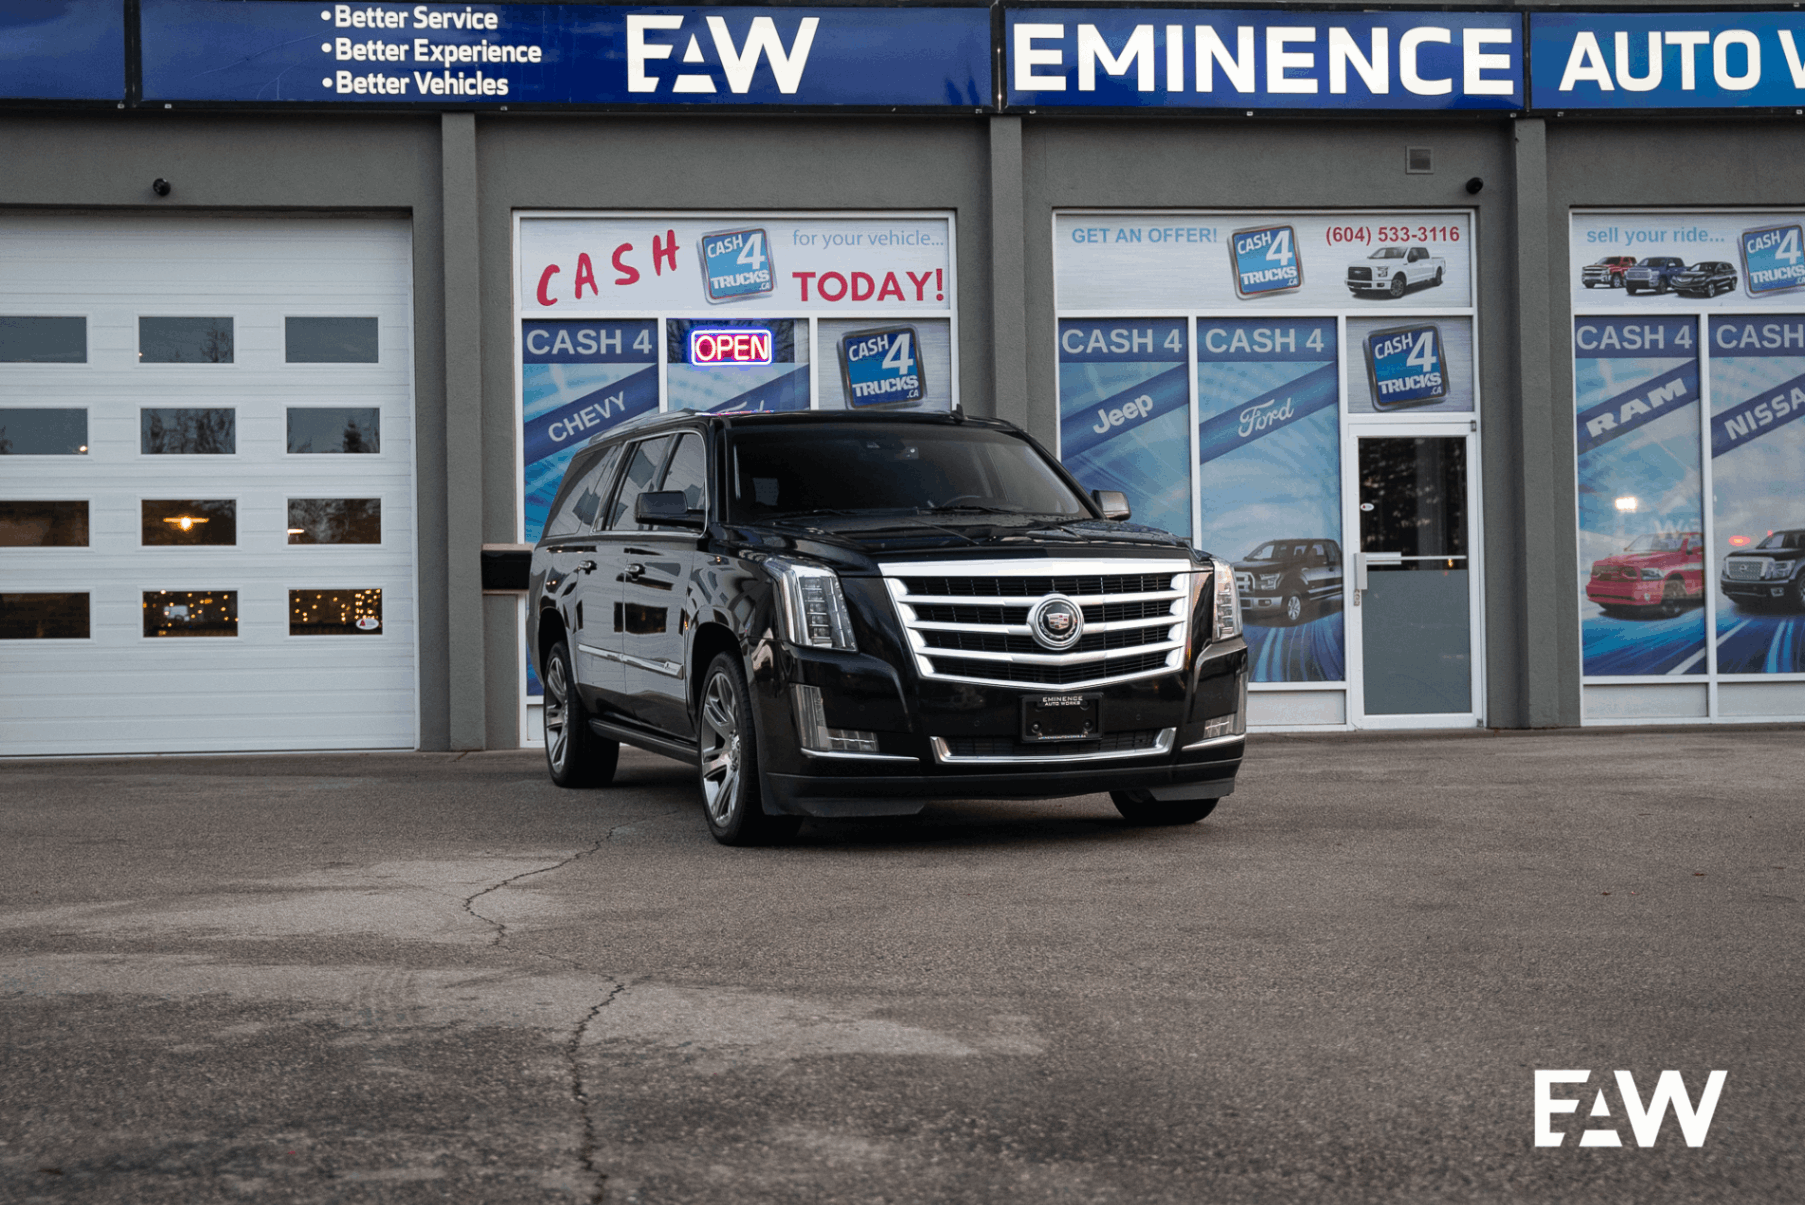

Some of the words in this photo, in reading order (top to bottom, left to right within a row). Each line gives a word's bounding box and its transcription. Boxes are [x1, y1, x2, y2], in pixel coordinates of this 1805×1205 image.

[335, 5, 409, 29] Better
[413, 6, 499, 30] Service
[336, 37, 409, 61] Better
[414, 39, 543, 68] Experience
[626, 15, 820, 94] EAW
[1013, 23, 1514, 95] EMINENCE
[1559, 29, 1762, 91] AUTO
[336, 70, 410, 94] Better
[413, 70, 509, 95] Vehicles
[793, 229, 818, 246] for
[822, 233, 863, 250] your
[868, 229, 944, 246] vehicle...
[1072, 228, 1110, 243] GET
[1115, 228, 1142, 243] AN
[1148, 228, 1217, 243] OFFER!
[1237, 231, 1271, 254] CASH
[1265, 230, 1293, 266] 4
[1326, 226, 1372, 246] (604)
[1378, 226, 1460, 242] 533-3116
[1587, 227, 1618, 243] sell
[1625, 230, 1667, 246] your
[1673, 227, 1725, 243] ride...
[1747, 230, 1780, 254] CASH
[1775, 229, 1802, 265] 4
[707, 234, 743, 258] CASH
[736, 233, 766, 270] 4
[537, 229, 680, 306] CASH
[710, 269, 770, 289] TRUCKS
[1241, 266, 1297, 285] TRUCKS
[1750, 265, 1805, 284] TRUCKS
[792, 268, 944, 302] TODAY!
[526, 329, 622, 355] CASH
[633, 329, 652, 354] 4
[694, 334, 770, 362] OPEN
[1062, 329, 1153, 353] CASH
[1163, 329, 1182, 353] 4
[1205, 328, 1296, 353] CASH
[1305, 328, 1325, 353] 4
[1576, 325, 1664, 350] CASH
[1674, 325, 1693, 349] 4
[1716, 324, 1804, 349] CASH
[848, 334, 889, 362] CASH
[882, 333, 914, 375] 4
[1374, 332, 1412, 359] CASH
[1406, 331, 1437, 372] 4
[852, 375, 919, 397] TRUCKS
[1378, 372, 1442, 394] TRUCKS
[548, 391, 625, 442] CHEVY
[1093, 394, 1154, 434] Jeep
[1238, 397, 1295, 437] Ford
[1586, 377, 1688, 438] RAM
